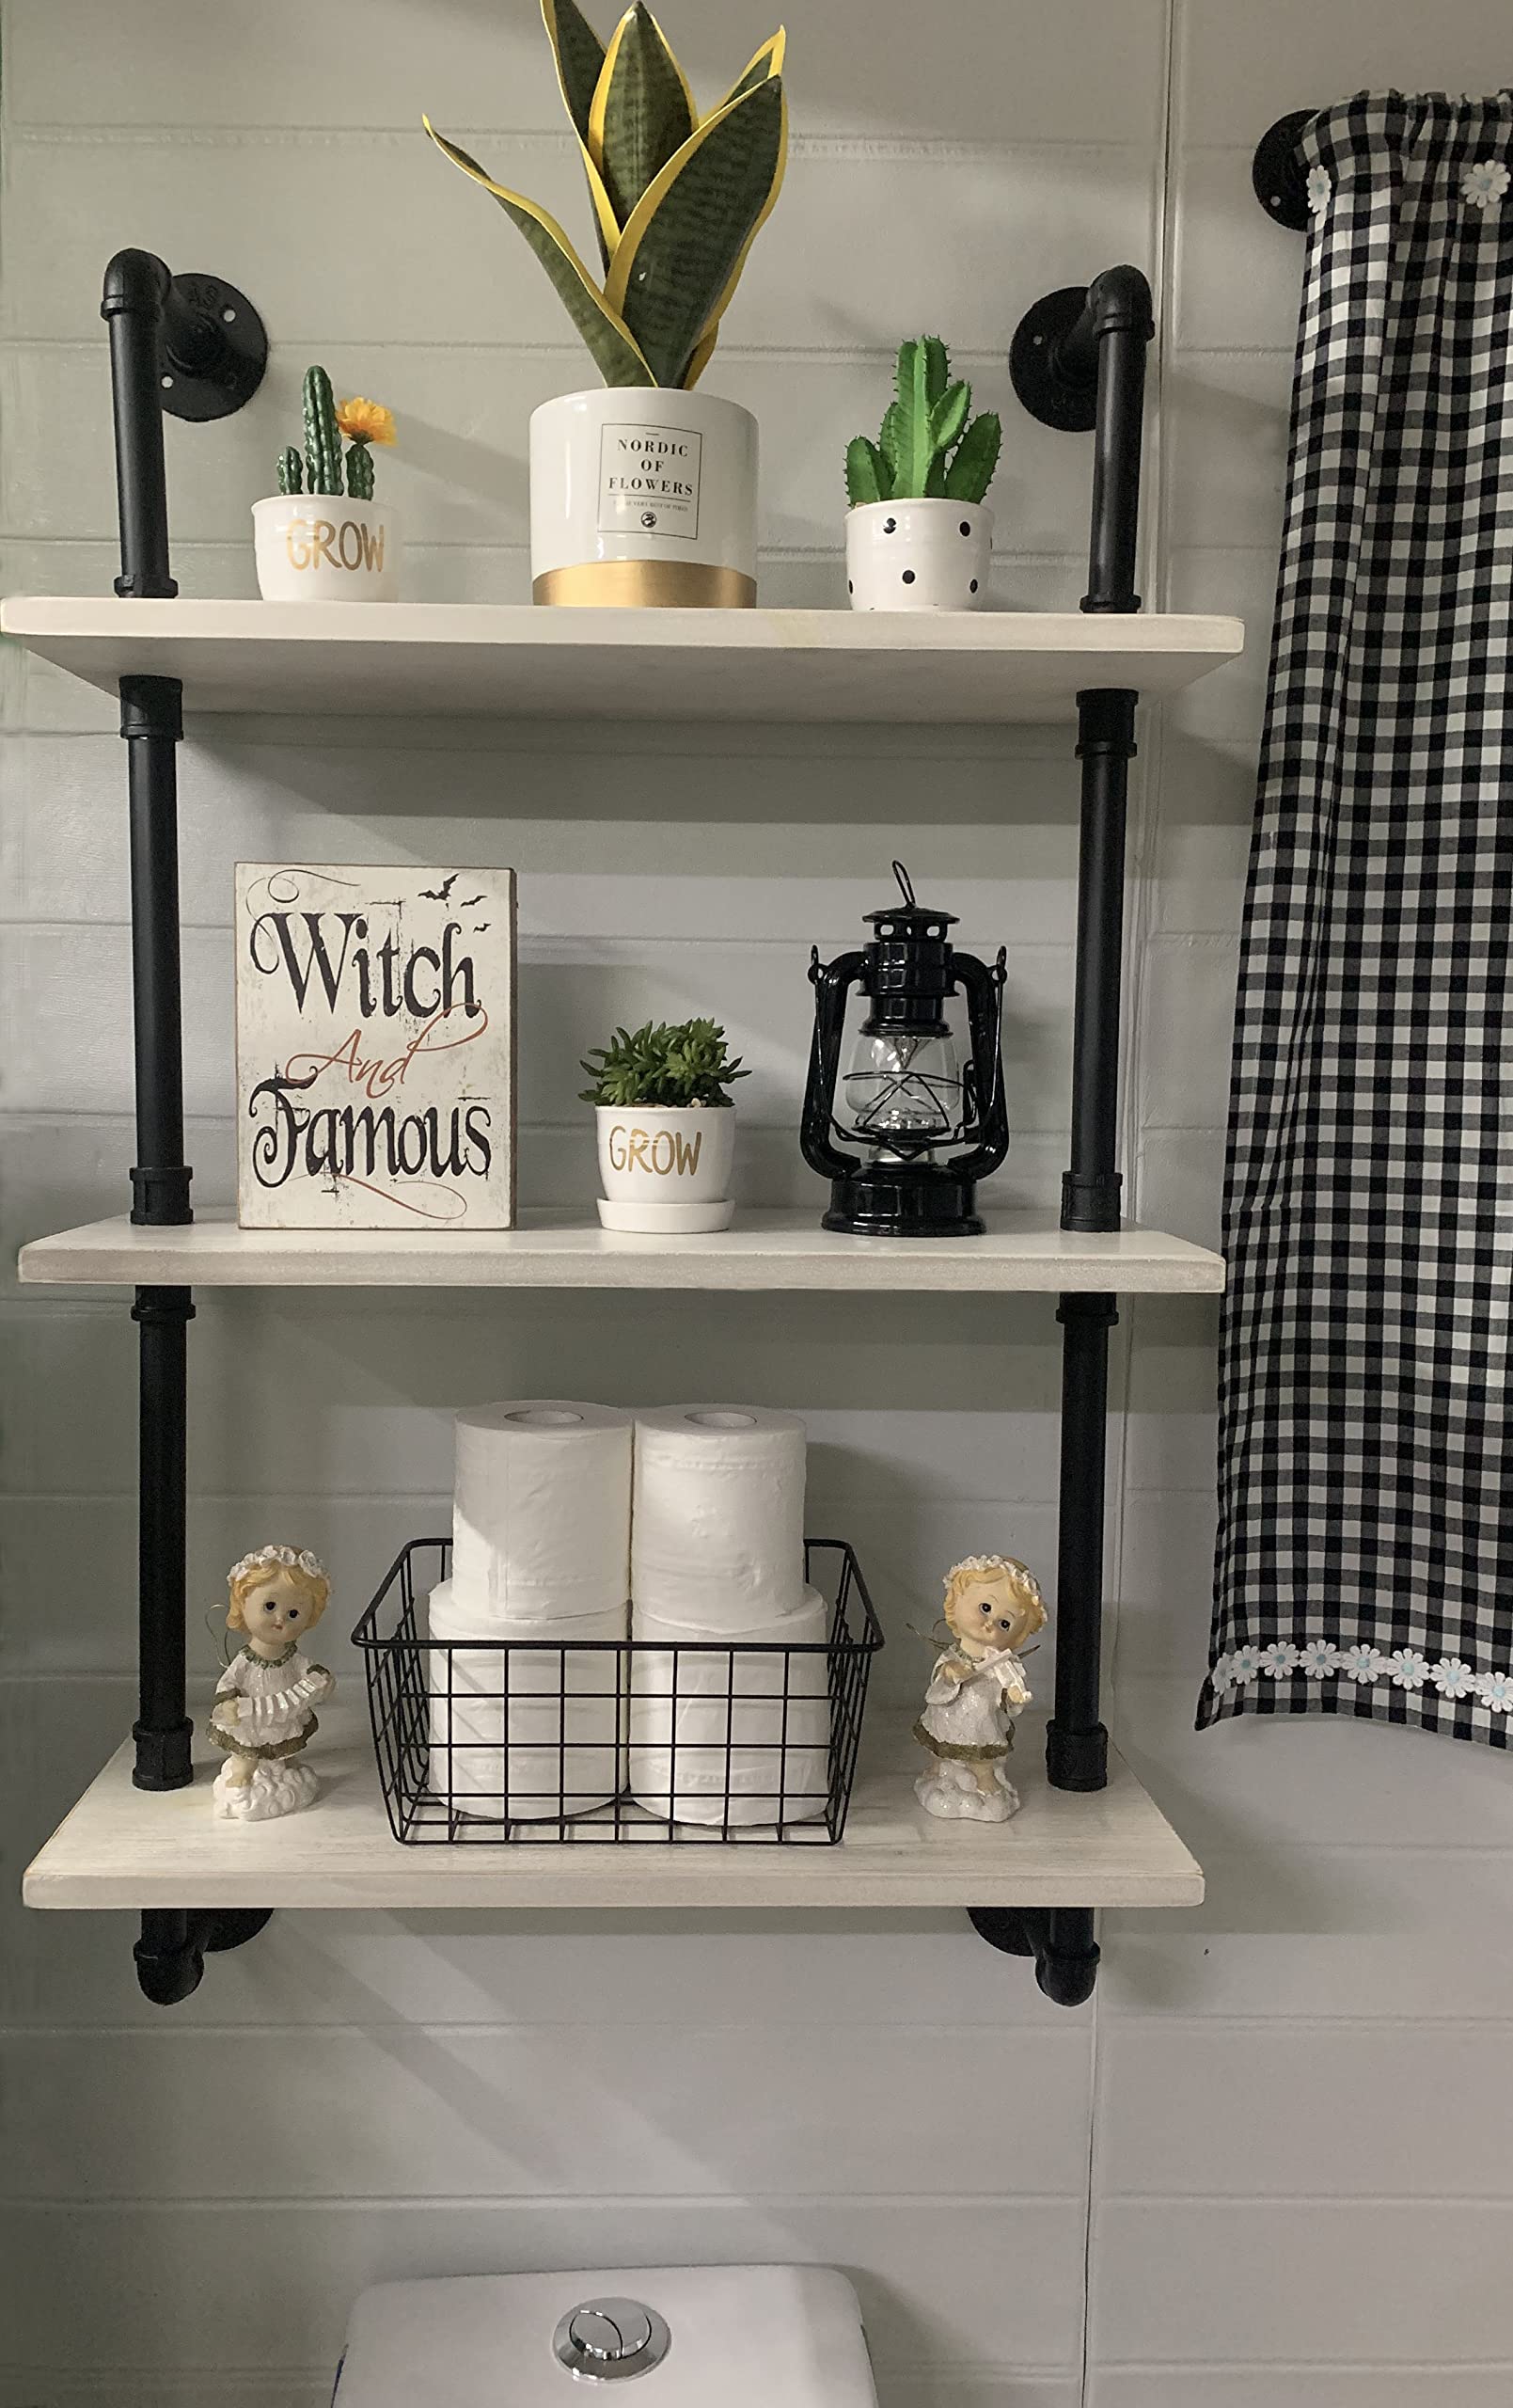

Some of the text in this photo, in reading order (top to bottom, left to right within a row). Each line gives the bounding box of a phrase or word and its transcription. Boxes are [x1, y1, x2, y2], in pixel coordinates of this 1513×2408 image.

[618, 438, 688, 457] NORDIC
[640, 459, 664, 472] OF
[608, 477, 693, 497] FLOWERS
[287, 518, 385, 573] GROW
[249, 911, 482, 1019] Witch
[285, 1002, 489, 1100] And
[249, 1066, 493, 1189] Famous
[609, 1125, 702, 1176] GROW
